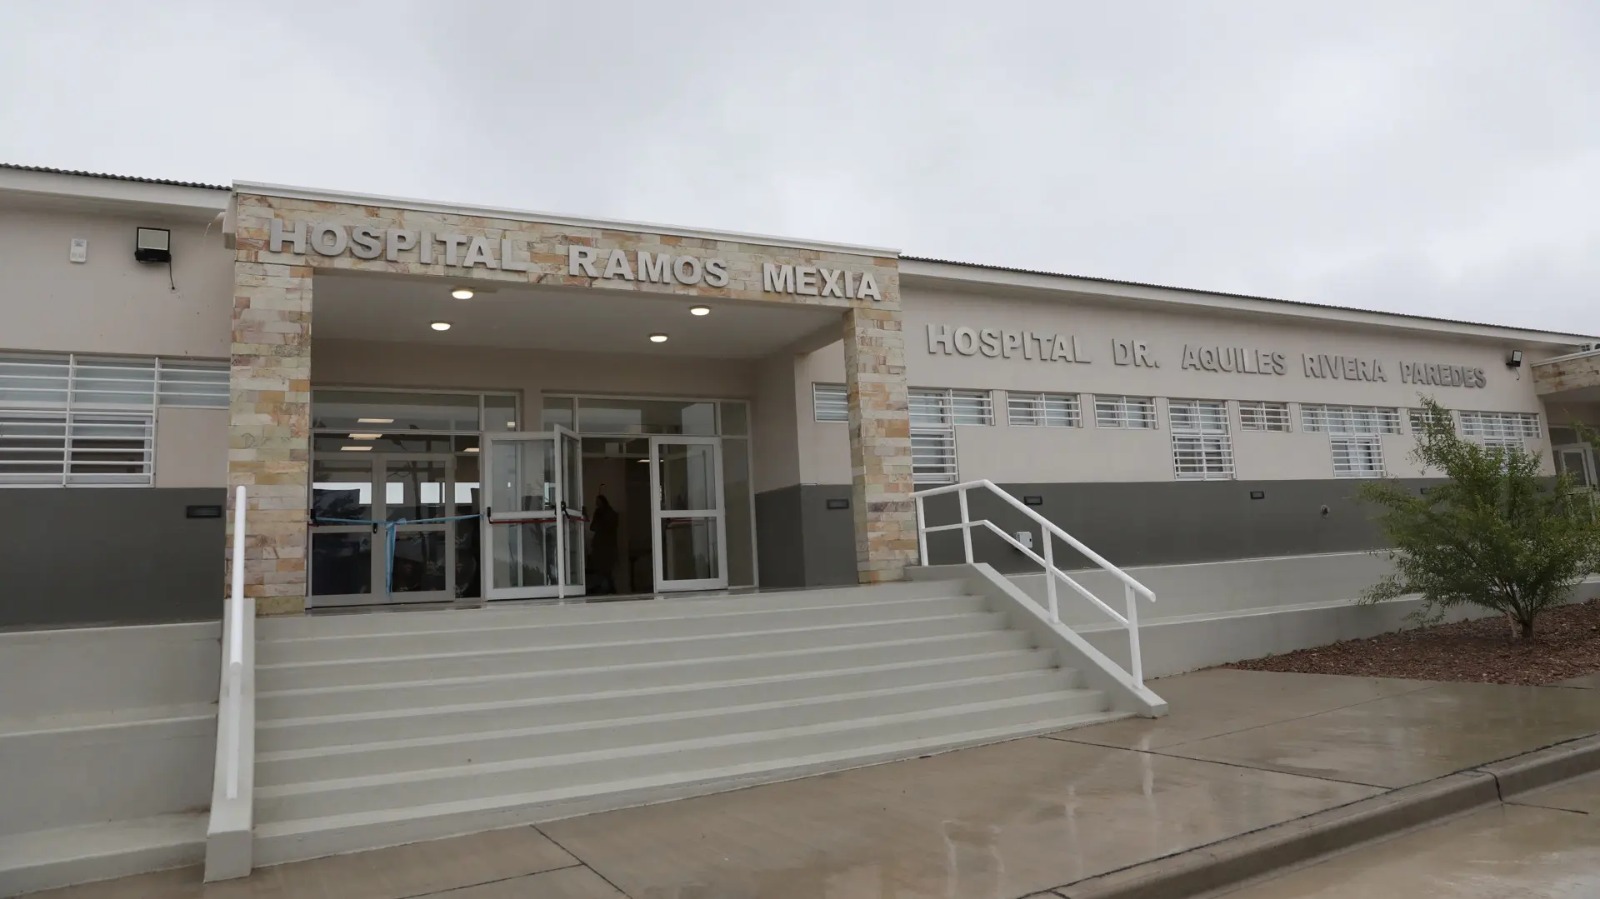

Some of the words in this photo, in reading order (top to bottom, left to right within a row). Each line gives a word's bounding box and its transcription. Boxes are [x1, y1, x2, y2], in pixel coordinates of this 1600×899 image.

[269, 218, 530, 272] HOSPITAL
[569, 245, 729, 288] RAMOS
[763, 263, 881, 301] MEXIA
[926, 323, 1091, 364] HOSPITAL
[1112, 338, 1160, 368] DR.
[1181, 344, 1287, 376] AQUILES
[1302, 353, 1387, 382] RIVERA
[1400, 360, 1487, 389] PAREDES
